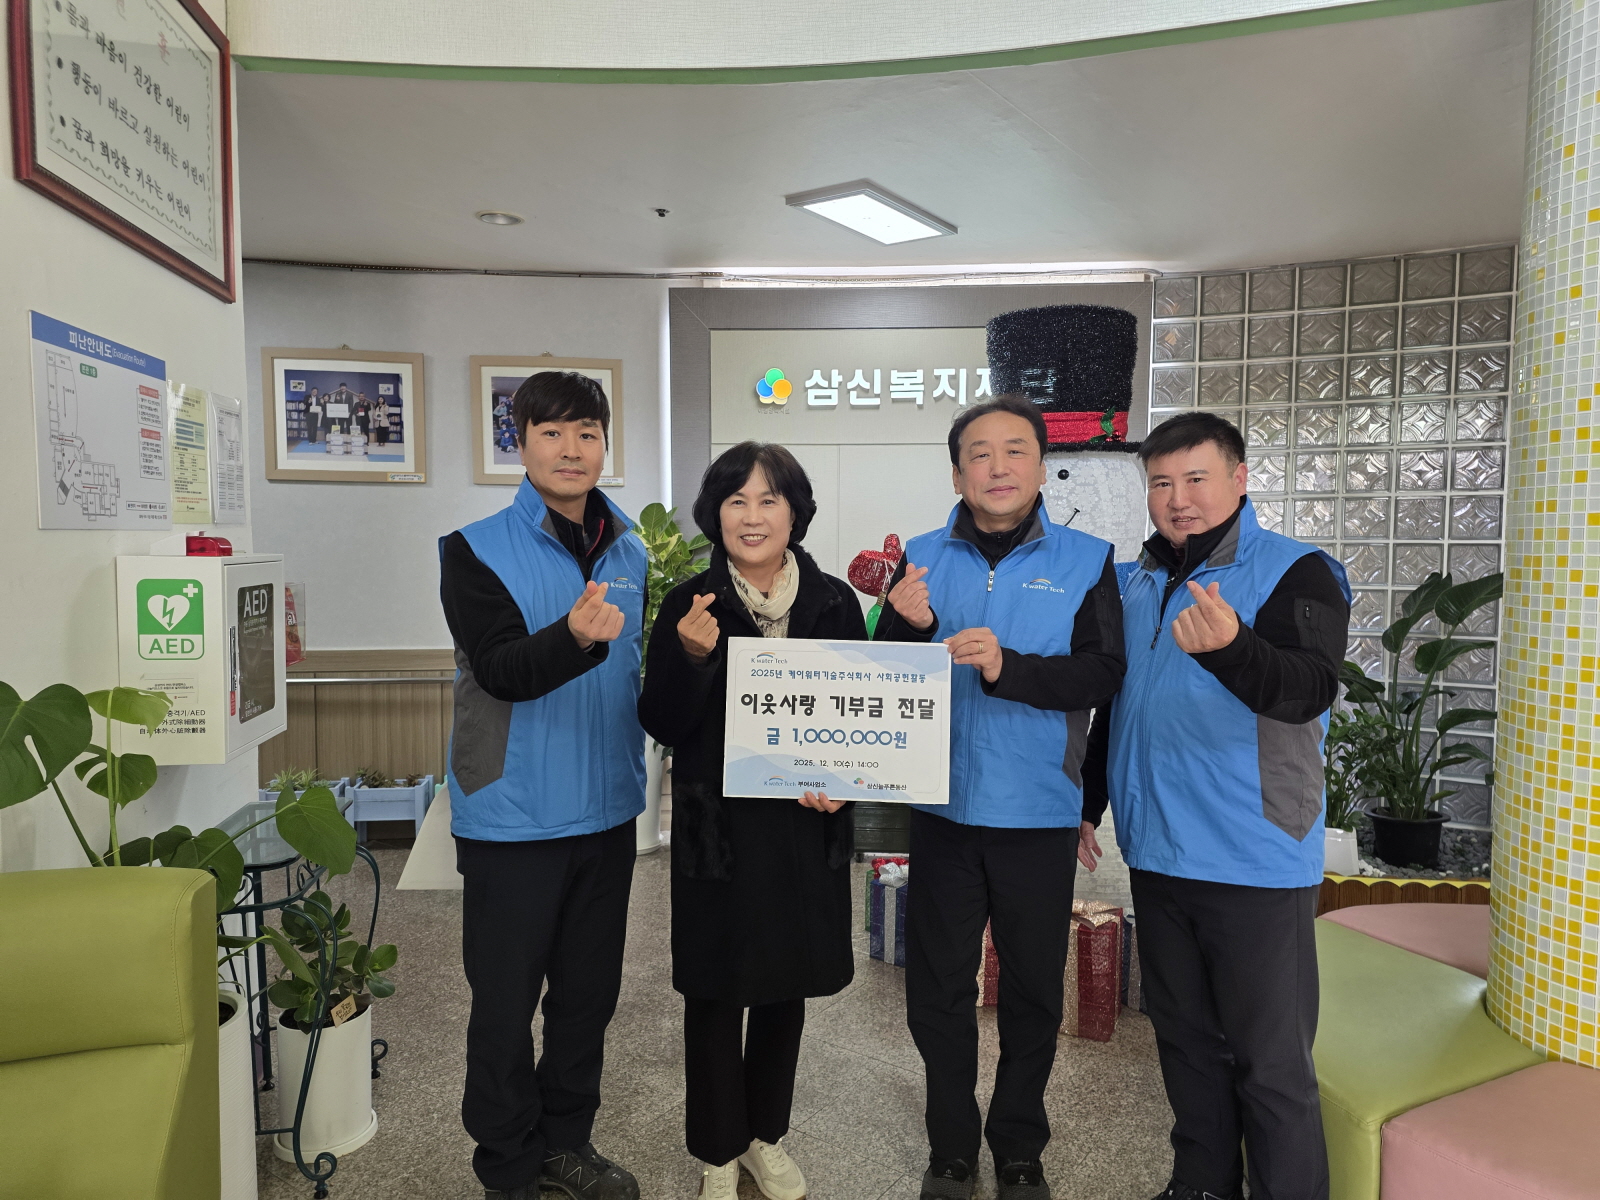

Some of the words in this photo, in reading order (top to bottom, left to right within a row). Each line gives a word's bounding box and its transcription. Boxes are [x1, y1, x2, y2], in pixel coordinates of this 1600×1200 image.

[95, 31, 127, 73] 마음이
[134, 65, 162, 105] 건강한
[166, 96, 190, 132] 어린이
[108, 97, 139, 134] 바르고
[143, 125, 178, 168] 실천하는
[182, 159, 206, 191] 어린이
[71, 117, 95, 152] 꿈과
[99, 140, 131, 178] 희망을
[135, 167, 163, 202] 키우는
[167, 192, 191, 222] 어린이
[804, 368, 1056, 406] 삼신복지
[243, 589, 268, 618] AED
[148, 638, 195, 654] AED
[750, 668, 783, 679] 2025년
[788, 670, 872, 682] 케이워터기술주식회사
[876, 672, 927, 684] 사회공헌활동
[167, 709, 206, 717] 충격기/AED
[740, 693, 816, 717] 이웃사랑
[829, 695, 884, 718] 기부금
[897, 697, 936, 720] 전달
[766, 727, 781, 746] 금
[792, 728, 908, 750] 1,000,000원
[833, 760, 854, 769] 10(수)
[857, 761, 879, 769] 14:00
